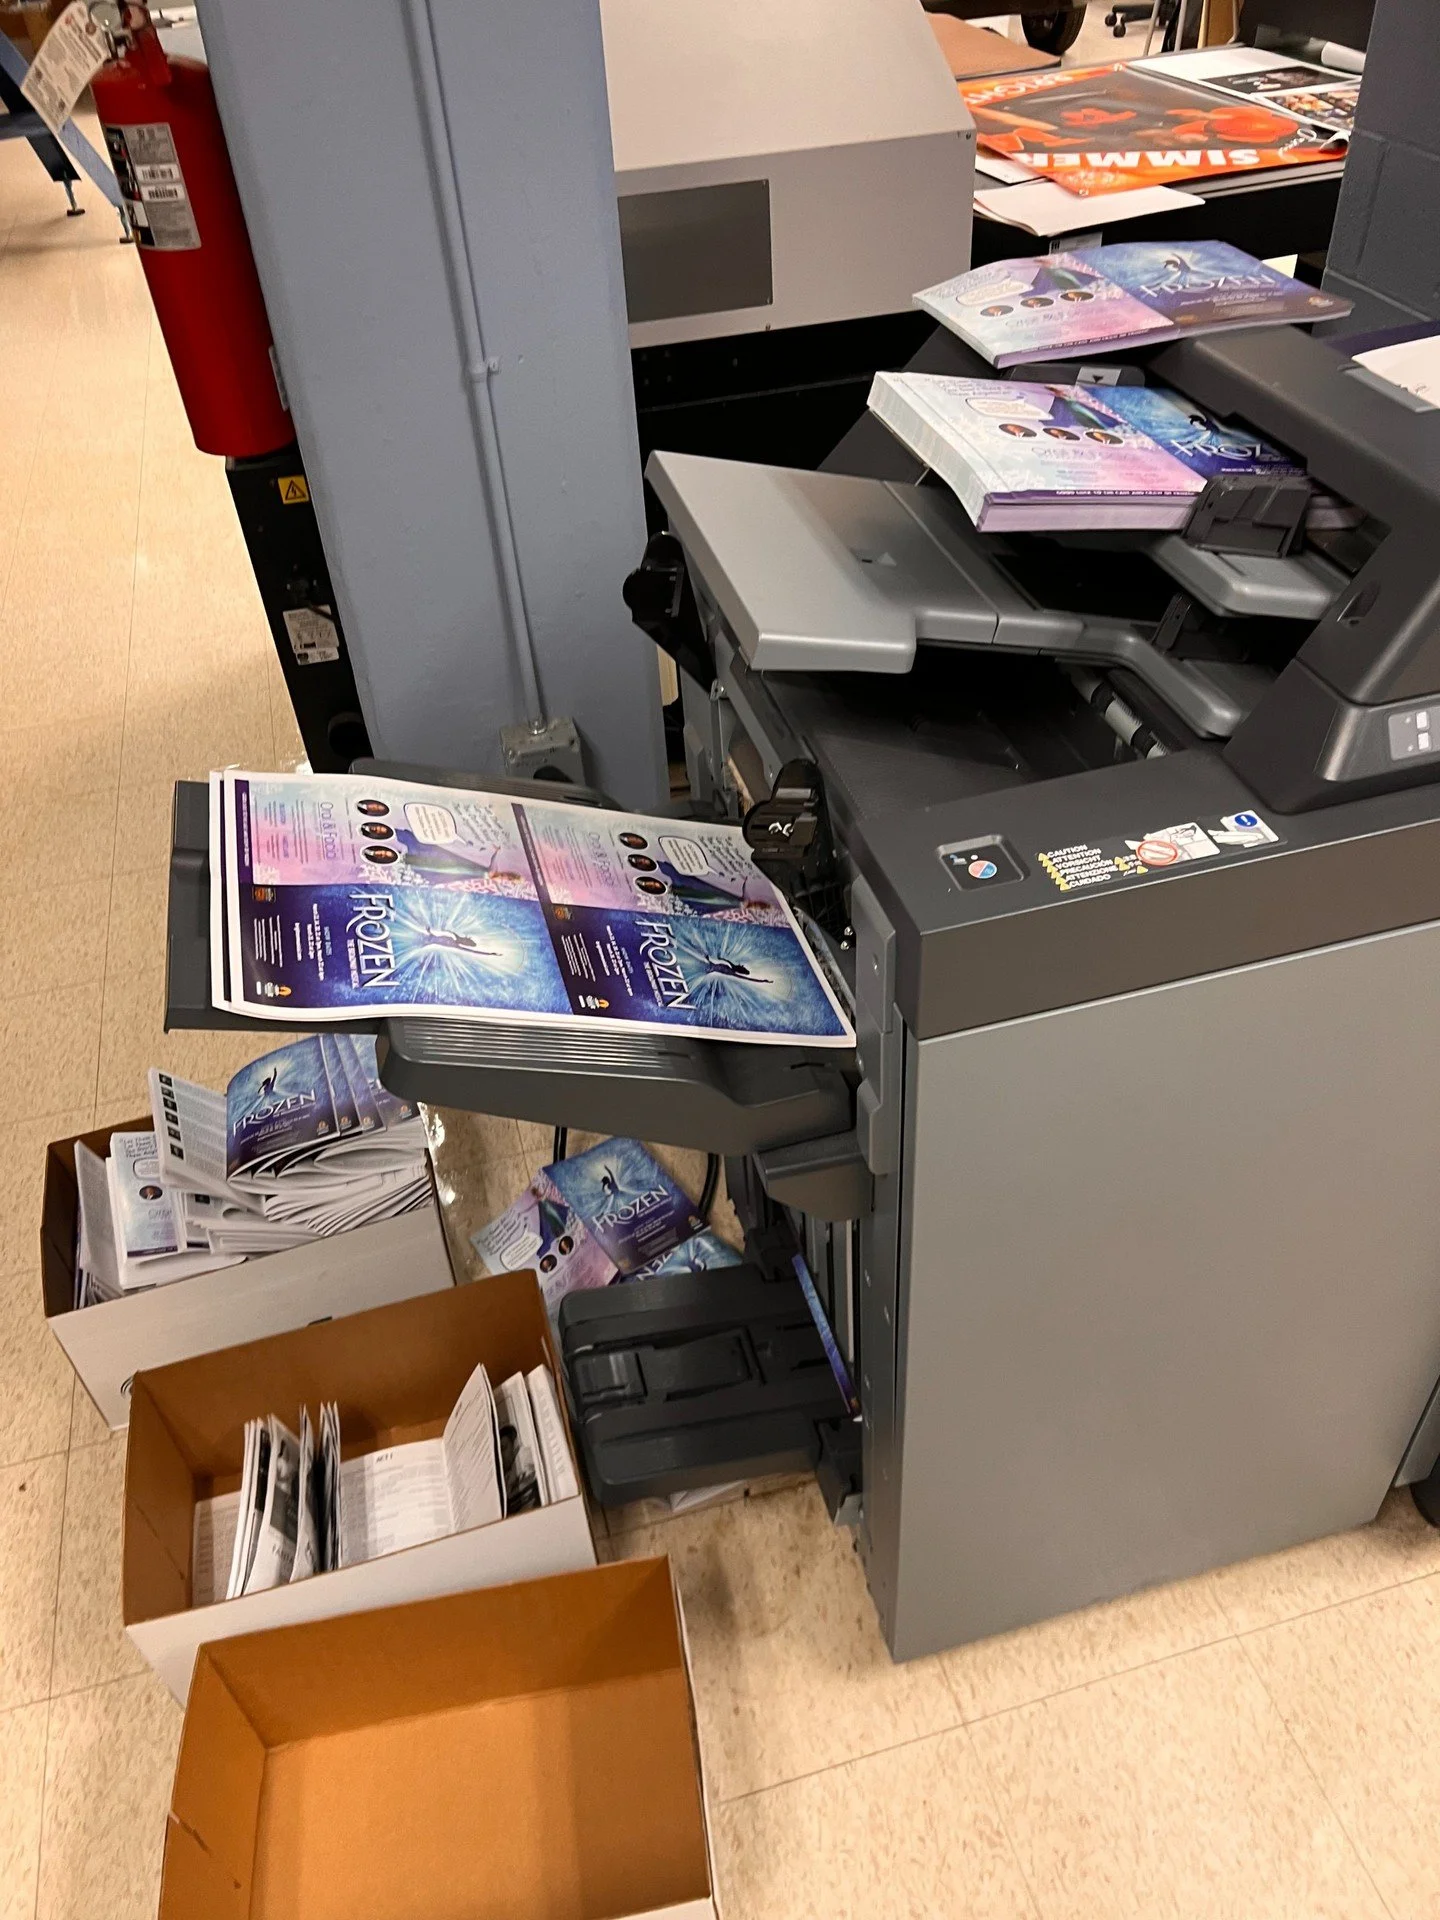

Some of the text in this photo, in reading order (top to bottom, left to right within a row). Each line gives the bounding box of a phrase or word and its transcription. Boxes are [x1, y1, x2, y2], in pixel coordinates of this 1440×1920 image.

[1013, 149, 1261, 168] SIMMER
[1046, 844, 1088, 858] CAUTION
[1051, 848, 1102, 863] ATTENTION
[1055, 855, 1101, 869] VORSICHT
[1065, 866, 1119, 881] ATTENZIONE
[1069, 874, 1111, 888] CUIDADO
[346, 892, 399, 988] FROZEN
[635, 920, 697, 1010] FROZEN
[232, 1088, 317, 1136] FROZEN
[591, 1184, 669, 1233] FROZEN
